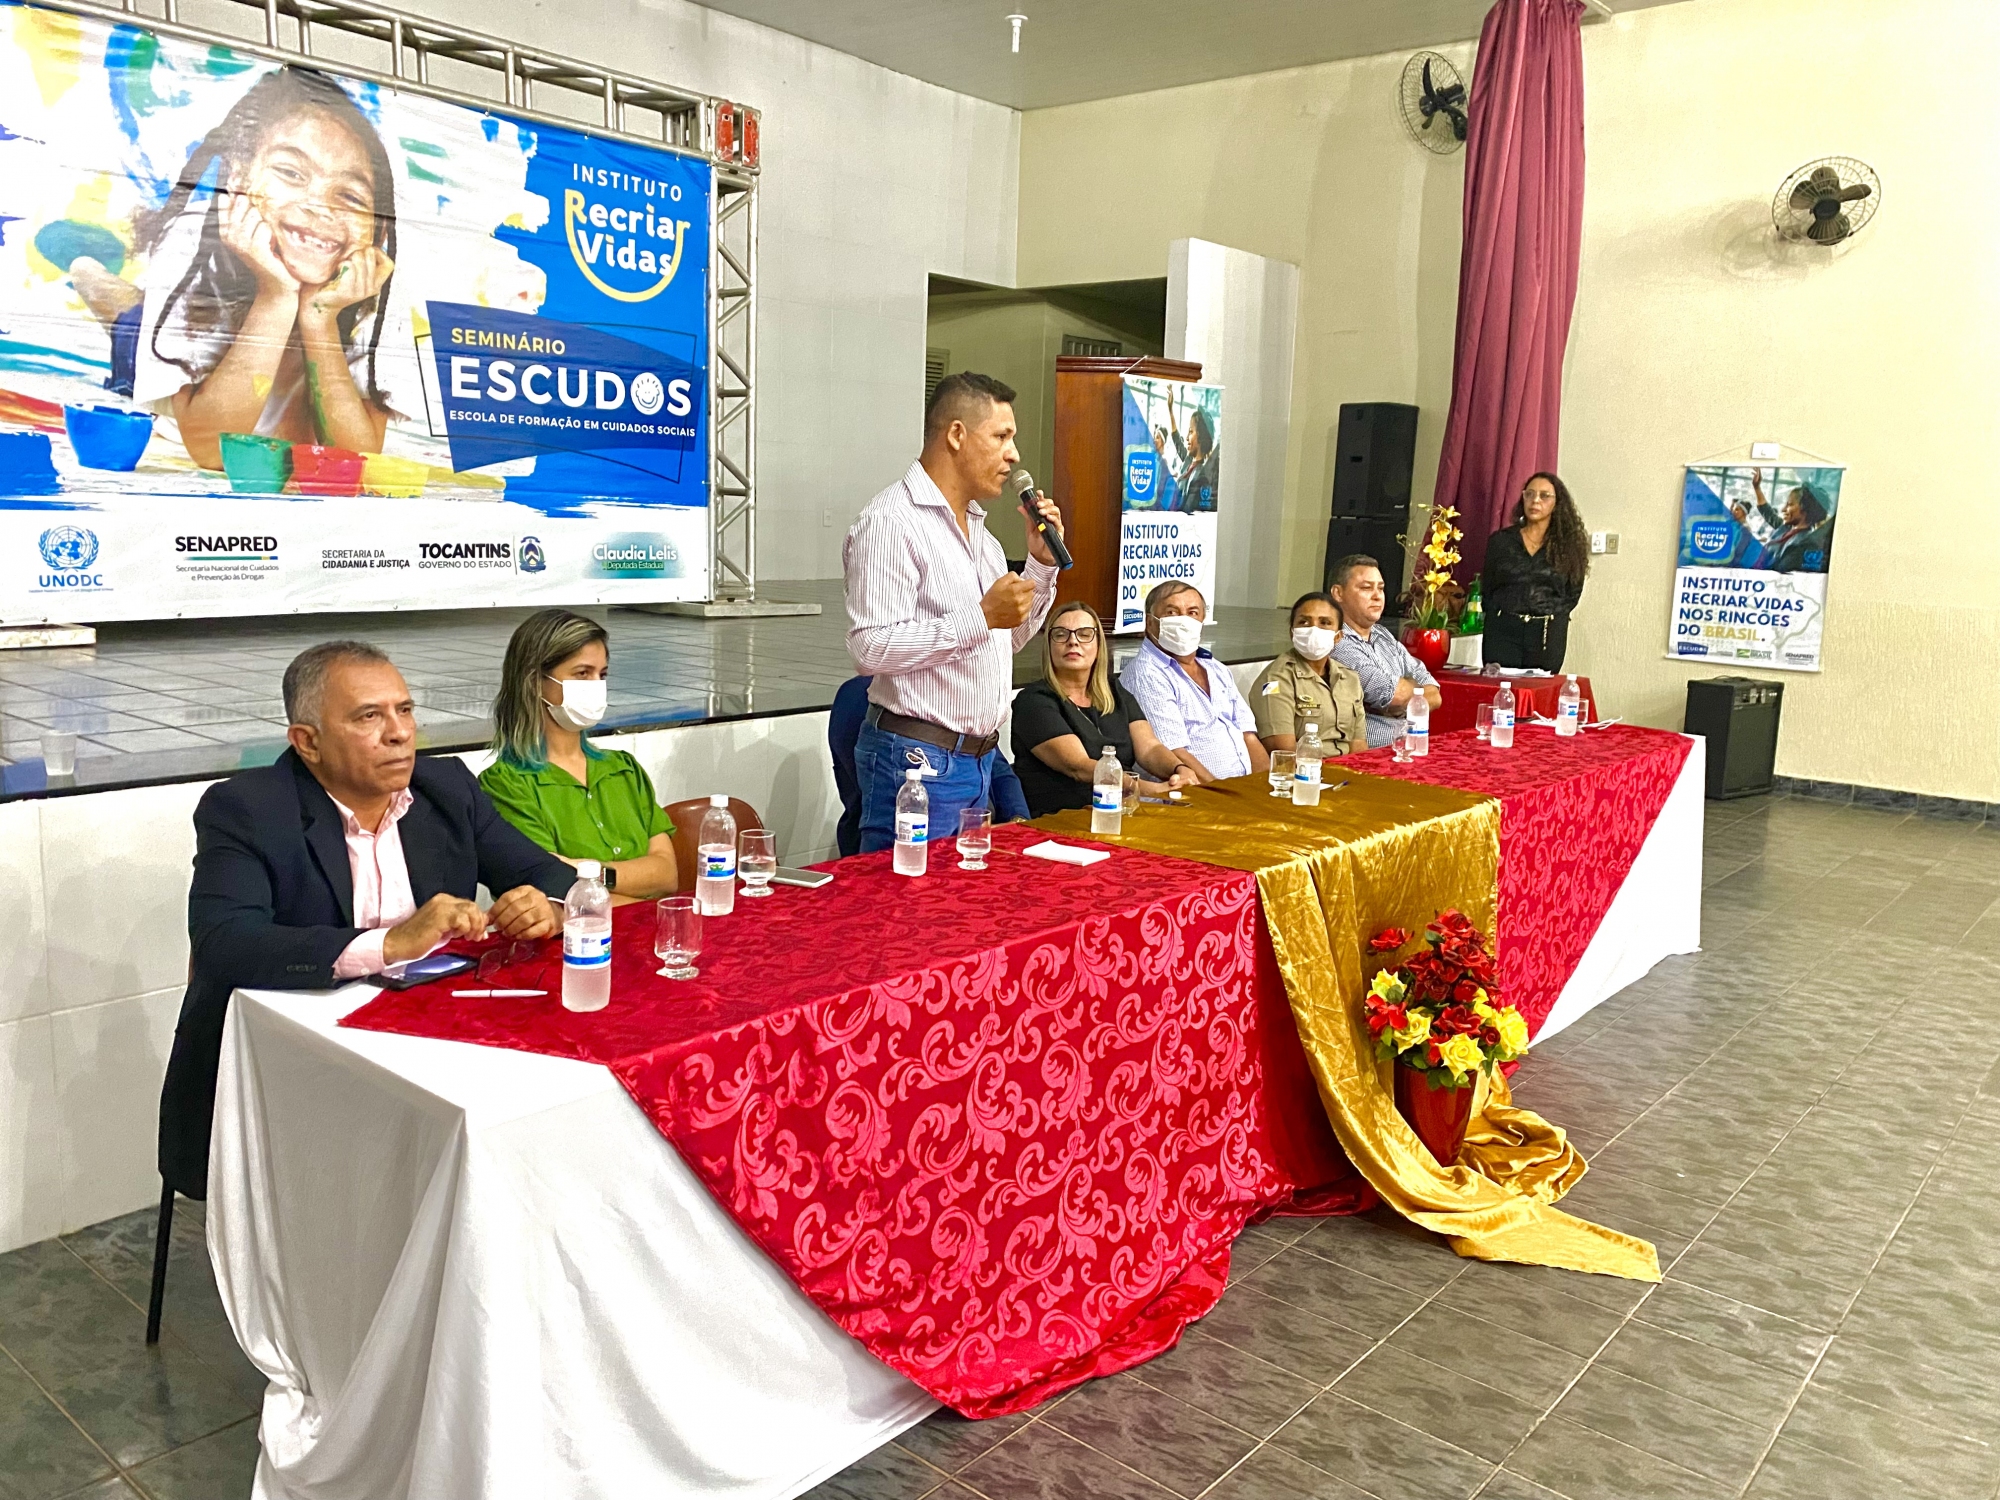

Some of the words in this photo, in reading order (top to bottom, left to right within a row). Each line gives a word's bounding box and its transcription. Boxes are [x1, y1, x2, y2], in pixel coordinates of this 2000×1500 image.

[573, 163, 682, 201] INSTITUTO
[564, 188, 691, 241] Recriar
[578, 229, 674, 276] Vidas
[451, 327, 566, 355] SEMINÁRIO
[450, 356, 692, 417] ESCUDOS
[450, 410, 497, 423] ESCOLA
[499, 413, 515, 424] DE
[518, 415, 580, 430] FORMAÇÃO
[584, 420, 599, 430] EM
[602, 421, 655, 434] CUIDADOS
[657, 425, 696, 437] SOCIAIS
[1123, 524, 1179, 539] INSTITUTO
[175, 536, 278, 552] SENAPRED
[419, 543, 511, 559] TOCANTINS
[593, 543, 646, 560] Claudia
[648, 544, 677, 560] Lelis
[1123, 544, 1169, 559] RECRIAR
[1172, 543, 1202, 558] VIDAS
[322, 549, 372, 559] SECRETARIA
[373, 549, 385, 558] DA
[211, 564, 240, 572] Nacional
[322, 559, 368, 569] CIDADANIA
[369, 559, 375, 568] E
[376, 559, 411, 570] JUSTIÇA
[418, 560, 462, 569] GOVERNO
[463, 560, 477, 569] DO
[478, 560, 512, 568] ESTADO
[608, 561, 638, 570] Deputada
[638, 561, 664, 570] Estadual
[1122, 564, 1146, 580] NOS
[1148, 559, 1195, 578] RINCÕES
[39, 574, 104, 588] UNODC
[197, 574, 232, 582] Prevenção
[240, 573, 265, 581] Drogas
[1682, 576, 1766, 593] INSTITUTO
[1122, 585, 1137, 600] DO
[1681, 592, 1748, 608] RECRIAR
[1753, 596, 1805, 612] VIDAS
[1679, 607, 1714, 622] NOS
[1718, 610, 1790, 628] RINCÕES
[1677, 623, 1701, 636] DO
